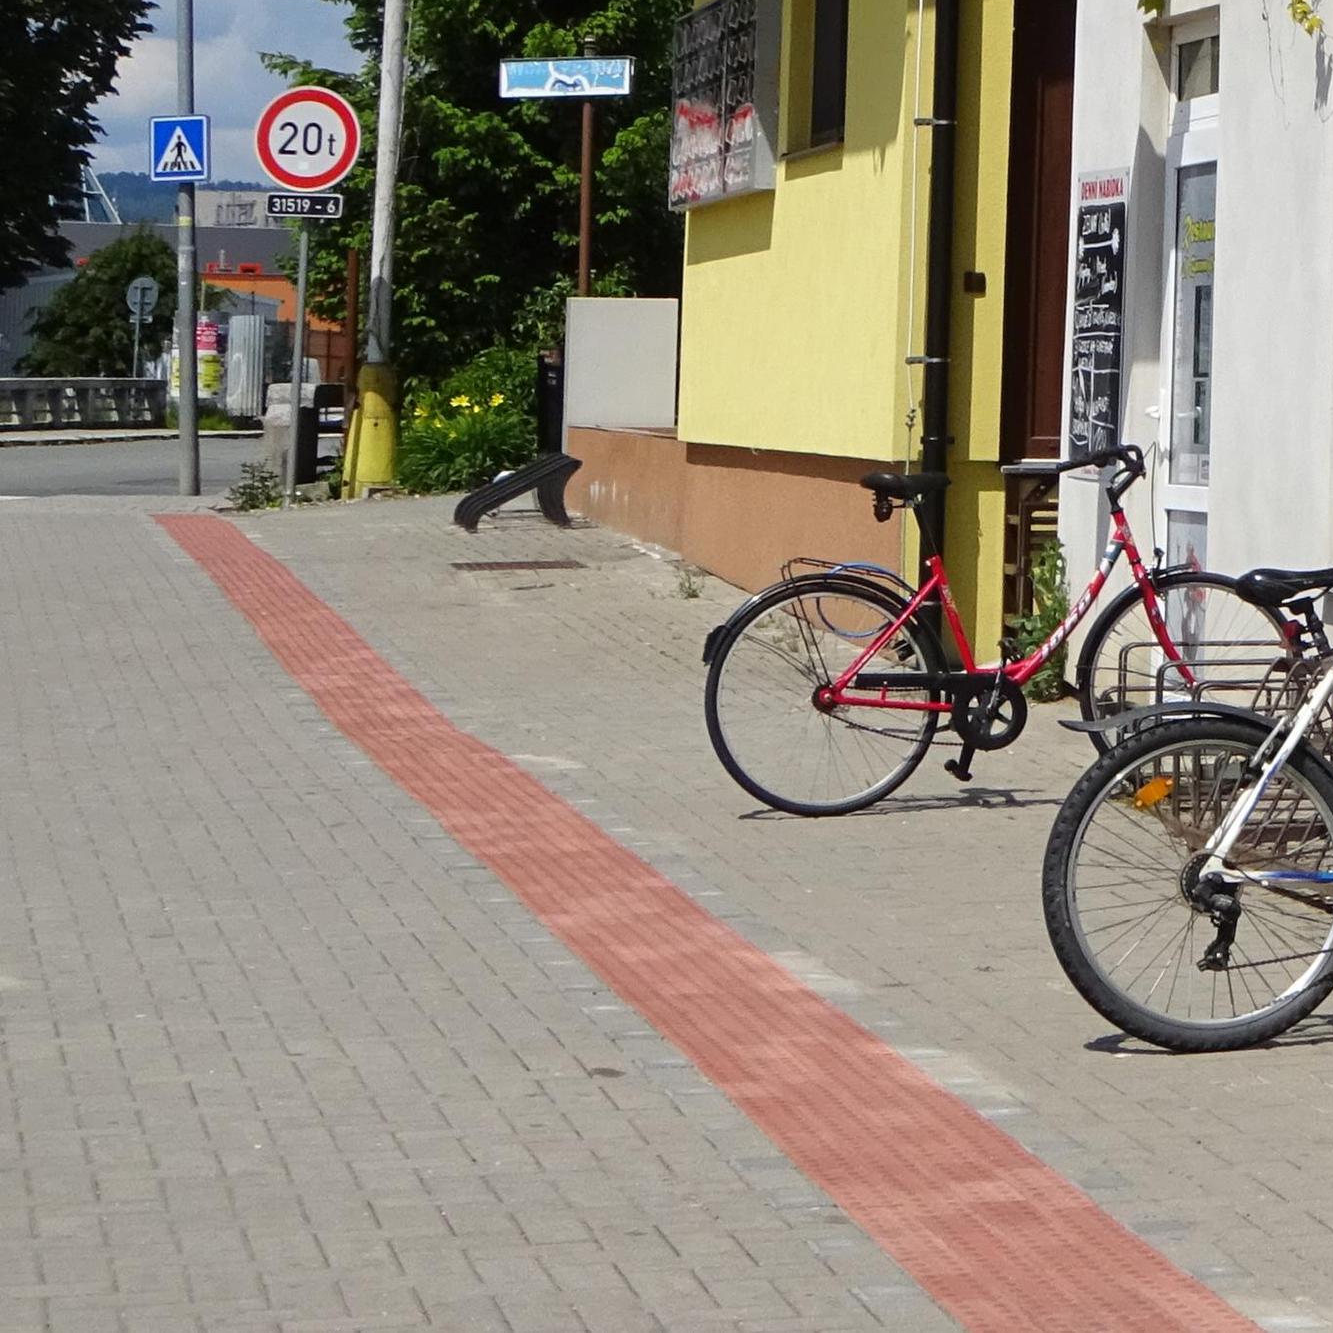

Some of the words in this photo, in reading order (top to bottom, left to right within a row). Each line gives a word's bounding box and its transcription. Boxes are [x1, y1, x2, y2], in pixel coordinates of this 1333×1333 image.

[279, 121, 323, 155] 20
[327, 133, 336, 156] t
[271, 198, 311, 213] 31519
[326, 200, 336, 214] 6
